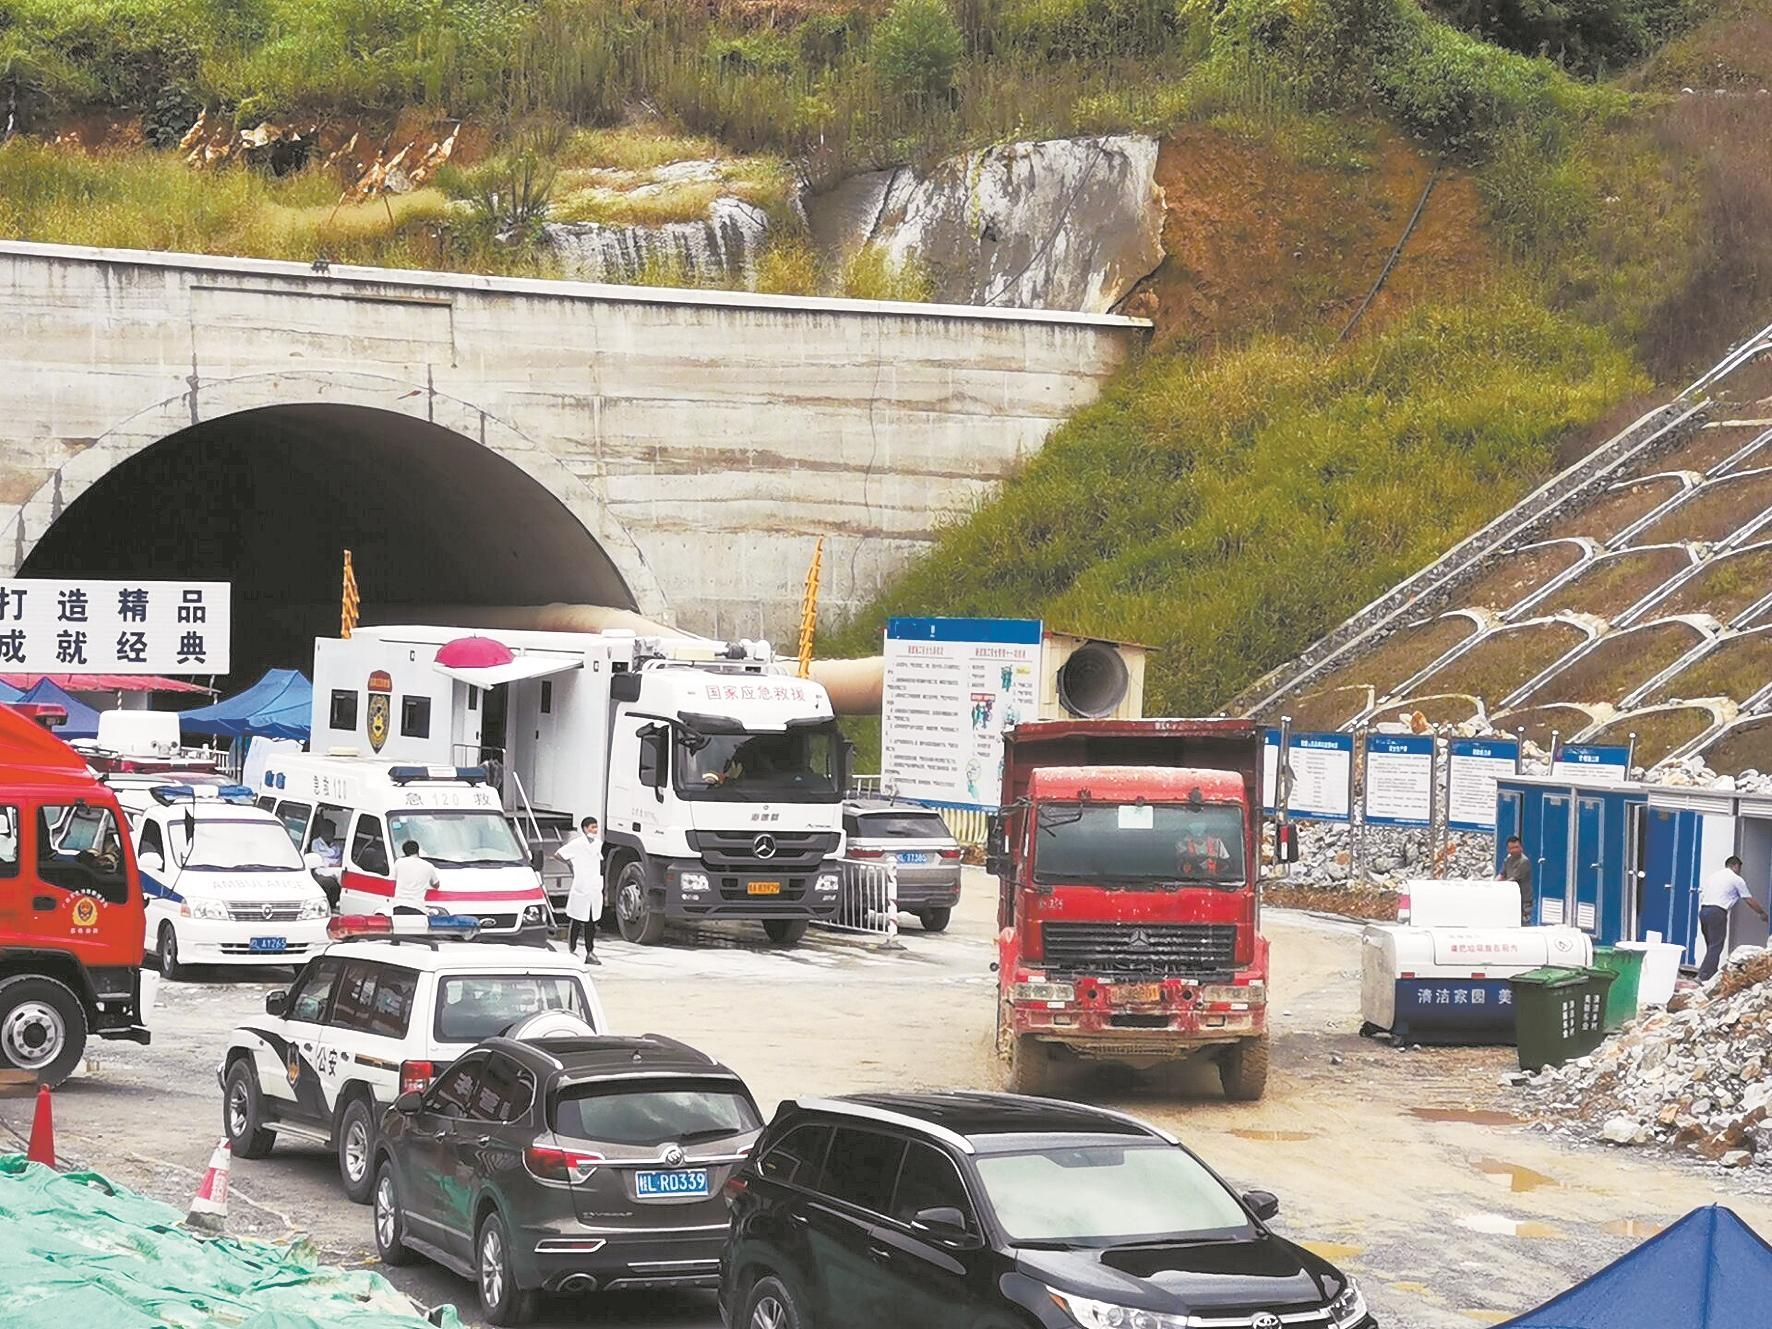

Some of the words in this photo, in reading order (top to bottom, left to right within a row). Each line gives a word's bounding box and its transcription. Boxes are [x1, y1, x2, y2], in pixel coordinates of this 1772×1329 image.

[0, 586, 206, 624] 打造精品
[0, 628, 207, 665] 成就经典
[705, 685, 806, 701] 国家应急救援
[212, 880, 305, 890] AMBULANCE
[1417, 988, 1486, 1005] 清洁家园
[316, 1047, 338, 1077] 公安
